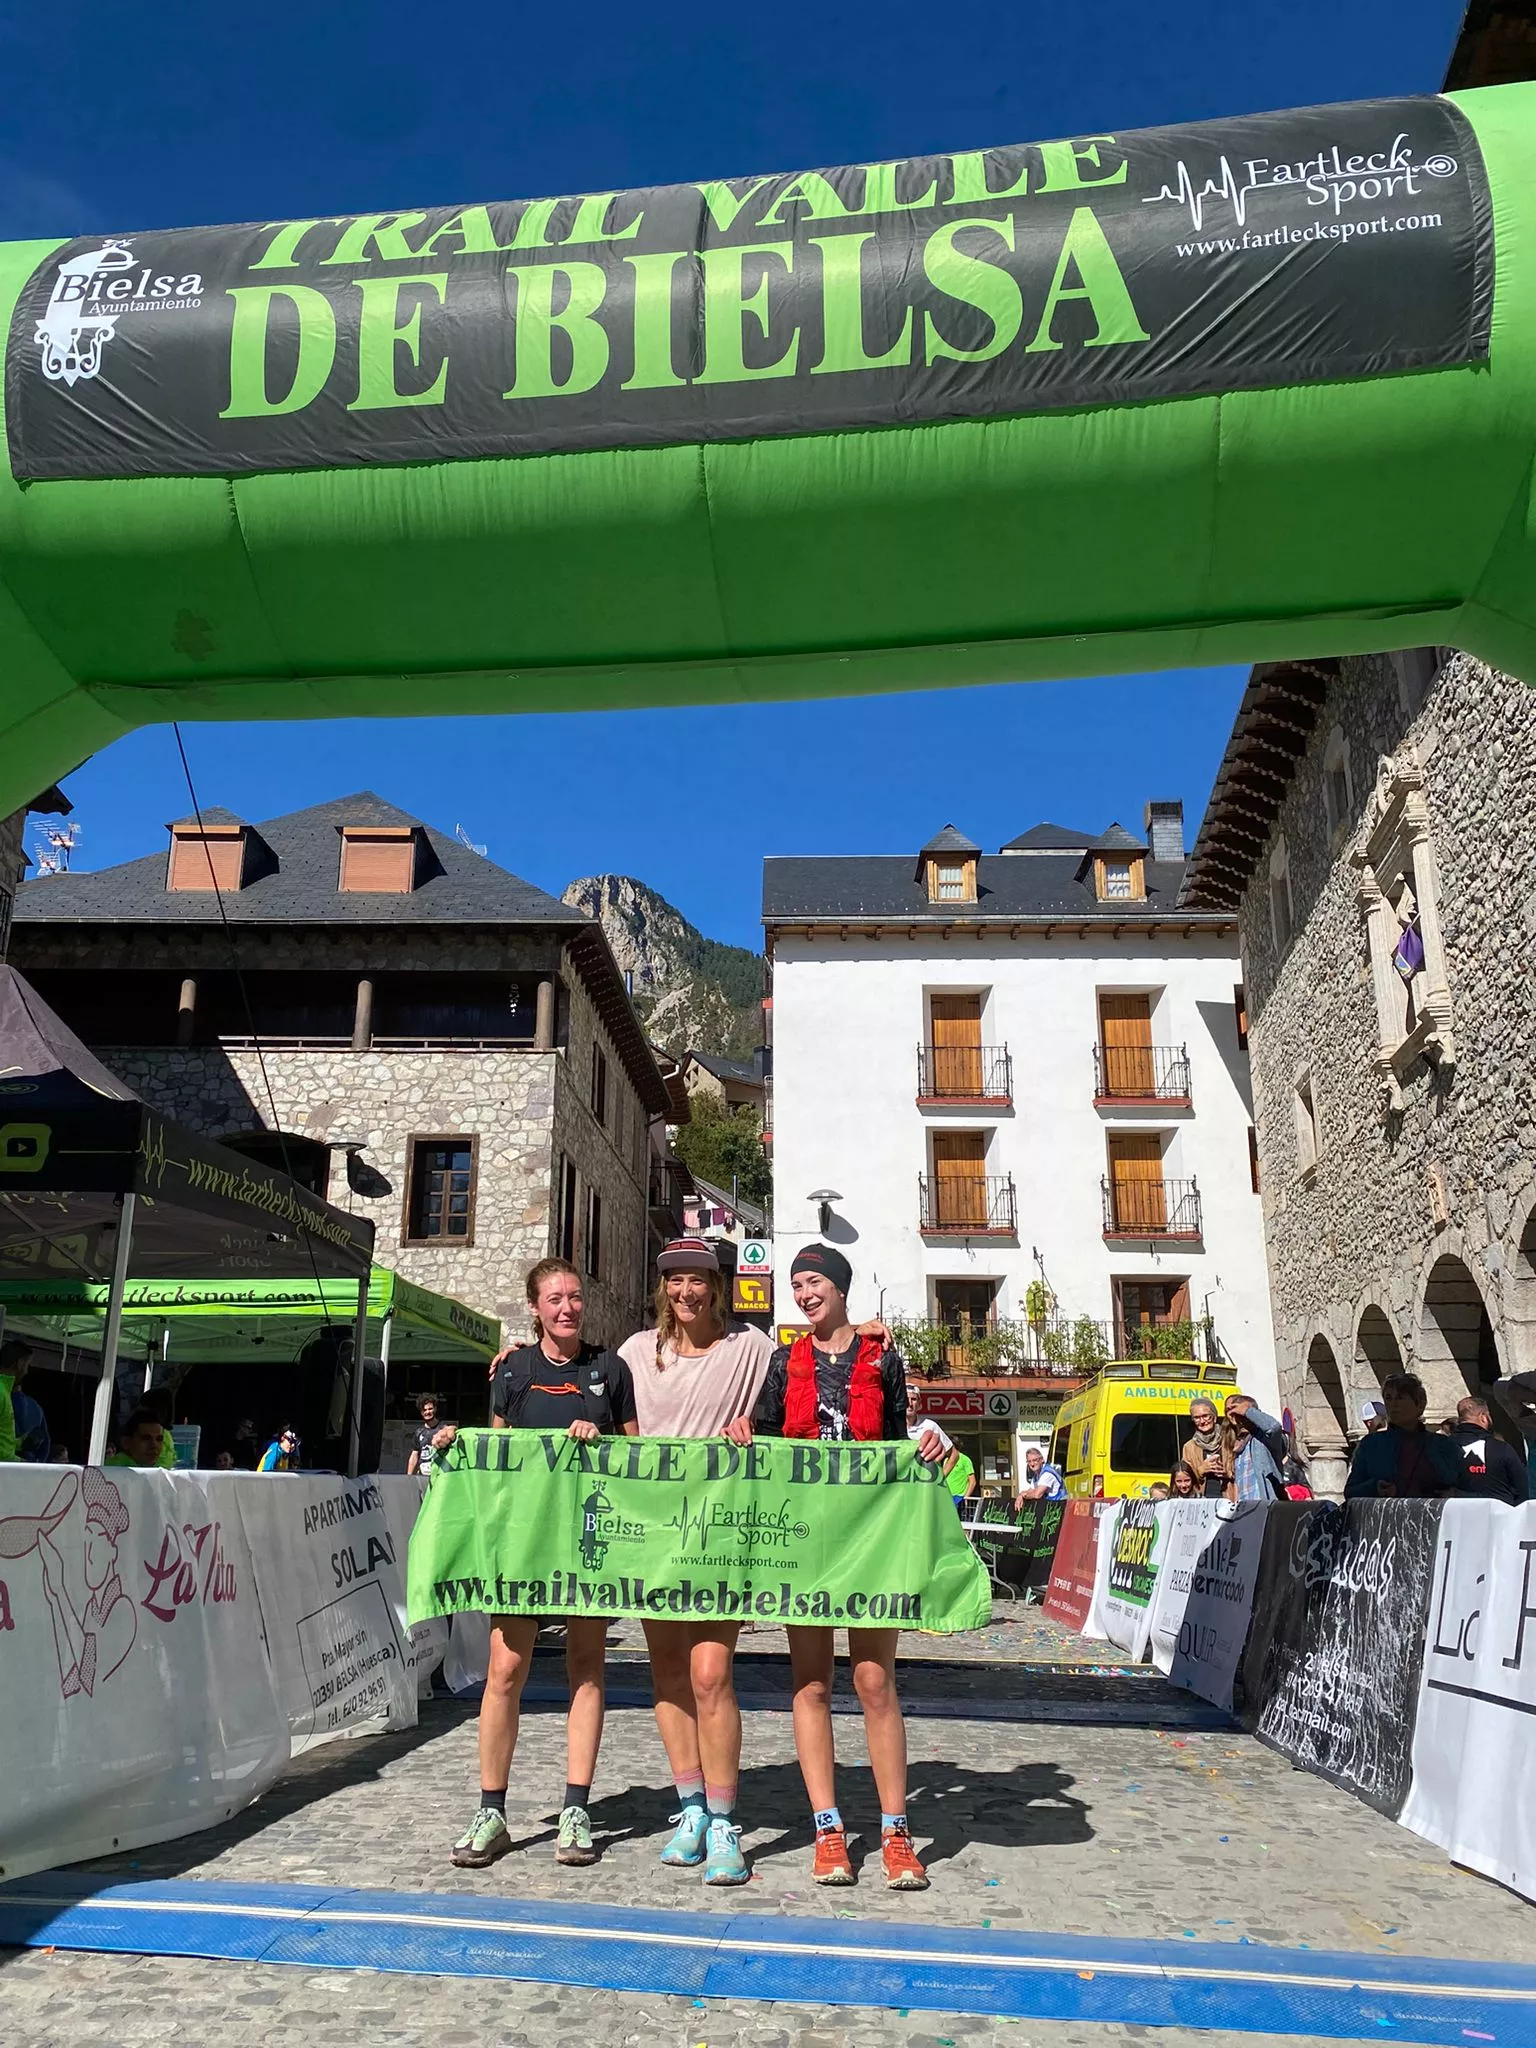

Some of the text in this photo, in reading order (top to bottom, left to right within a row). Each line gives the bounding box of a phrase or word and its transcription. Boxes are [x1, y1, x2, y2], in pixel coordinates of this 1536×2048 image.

[1243, 133, 1413, 186] Fartleck
[247, 136, 1128, 270] TRAIL VALLE
[1307, 166, 1422, 215] Sport
[1176, 213, 1442, 258] www.fartlecksport.com
[54, 268, 205, 303] Bielsa
[88, 296, 202, 316] Ayuntamiento
[218, 206, 1150, 419] DE BIELSA
[918, 1396, 983, 1411] PAR
[1125, 1386, 1225, 1400] AMBULANCIA
[539, 1434, 687, 1482] VALLE
[703, 1442, 772, 1481] DE
[788, 1444, 948, 1487] BIELS
[585, 1512, 646, 1537] Bielsa
[711, 1498, 792, 1528] Fartleck
[737, 1523, 791, 1552] Sport
[671, 1553, 799, 1571] www.fartlecksport.com
